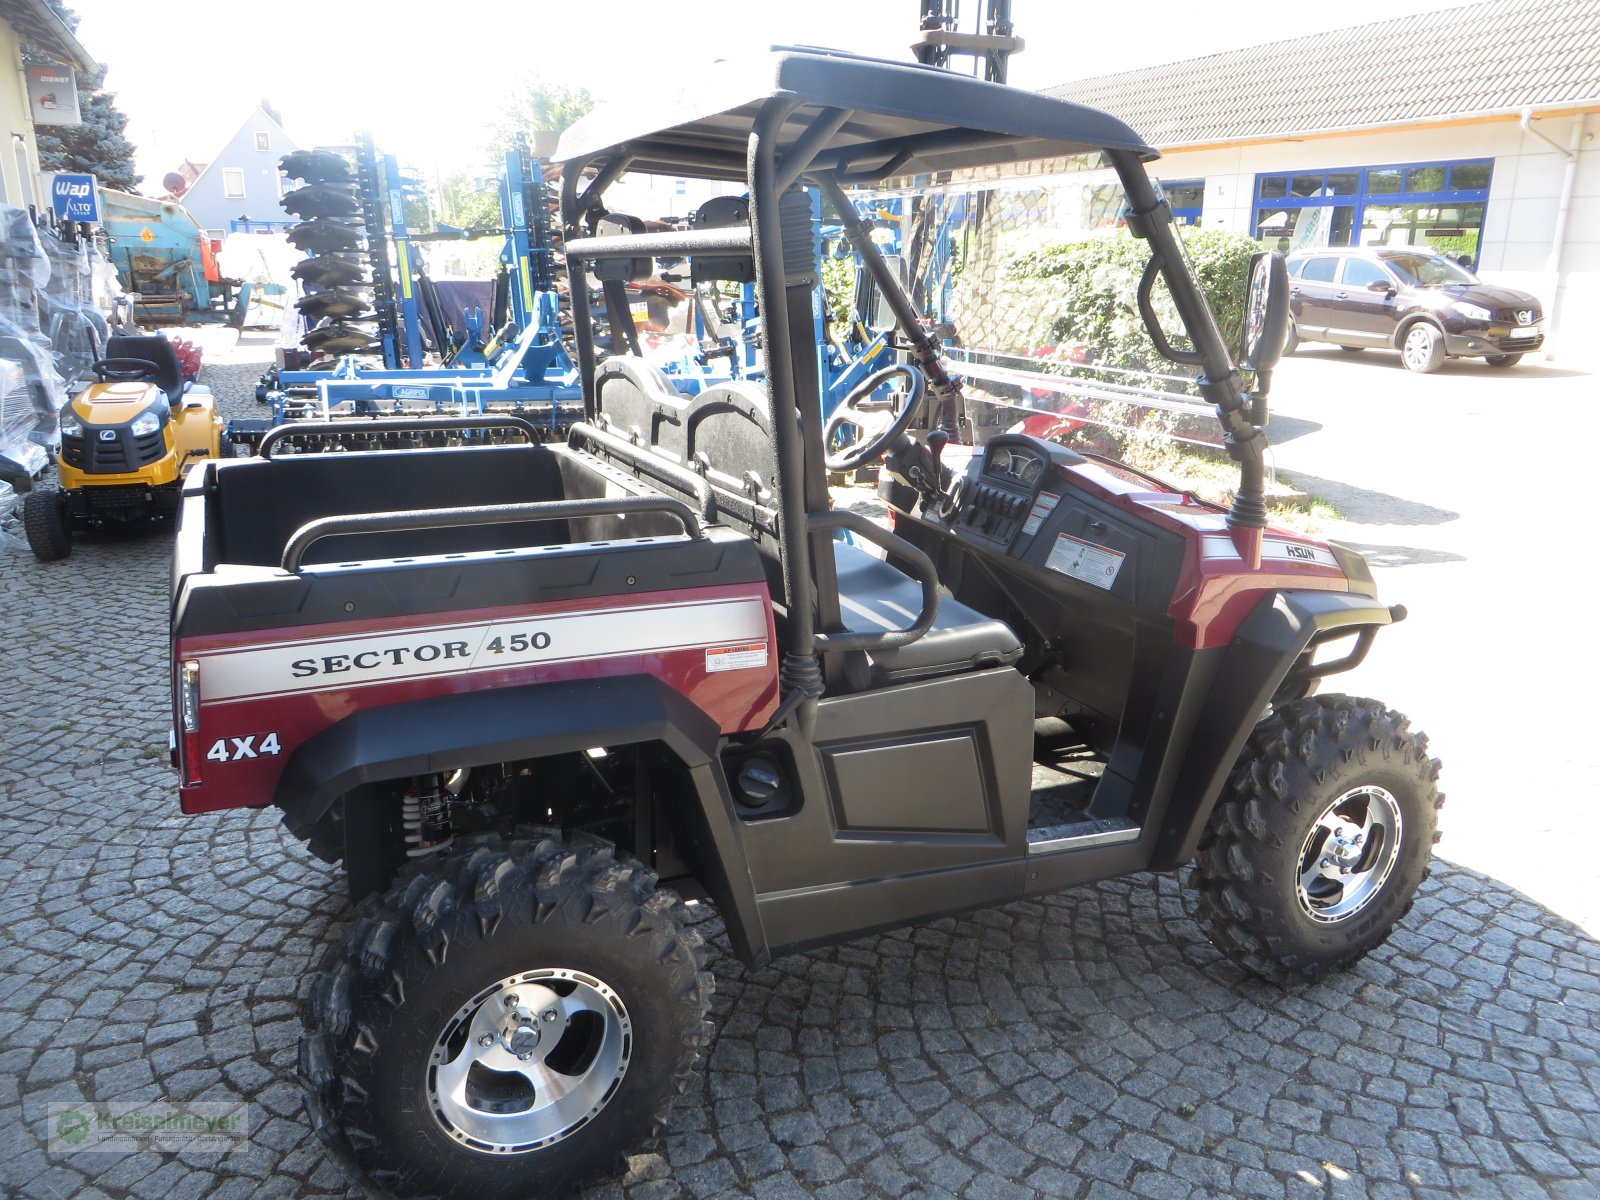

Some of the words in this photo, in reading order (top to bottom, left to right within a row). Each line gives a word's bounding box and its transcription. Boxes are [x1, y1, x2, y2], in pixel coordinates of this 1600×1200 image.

[56, 181, 90, 198] Wap
[1286, 545, 1315, 560] HSUN
[291, 640, 471, 678] SECTOR
[486, 631, 552, 654] 450
[206, 732, 282, 763] 4X4
